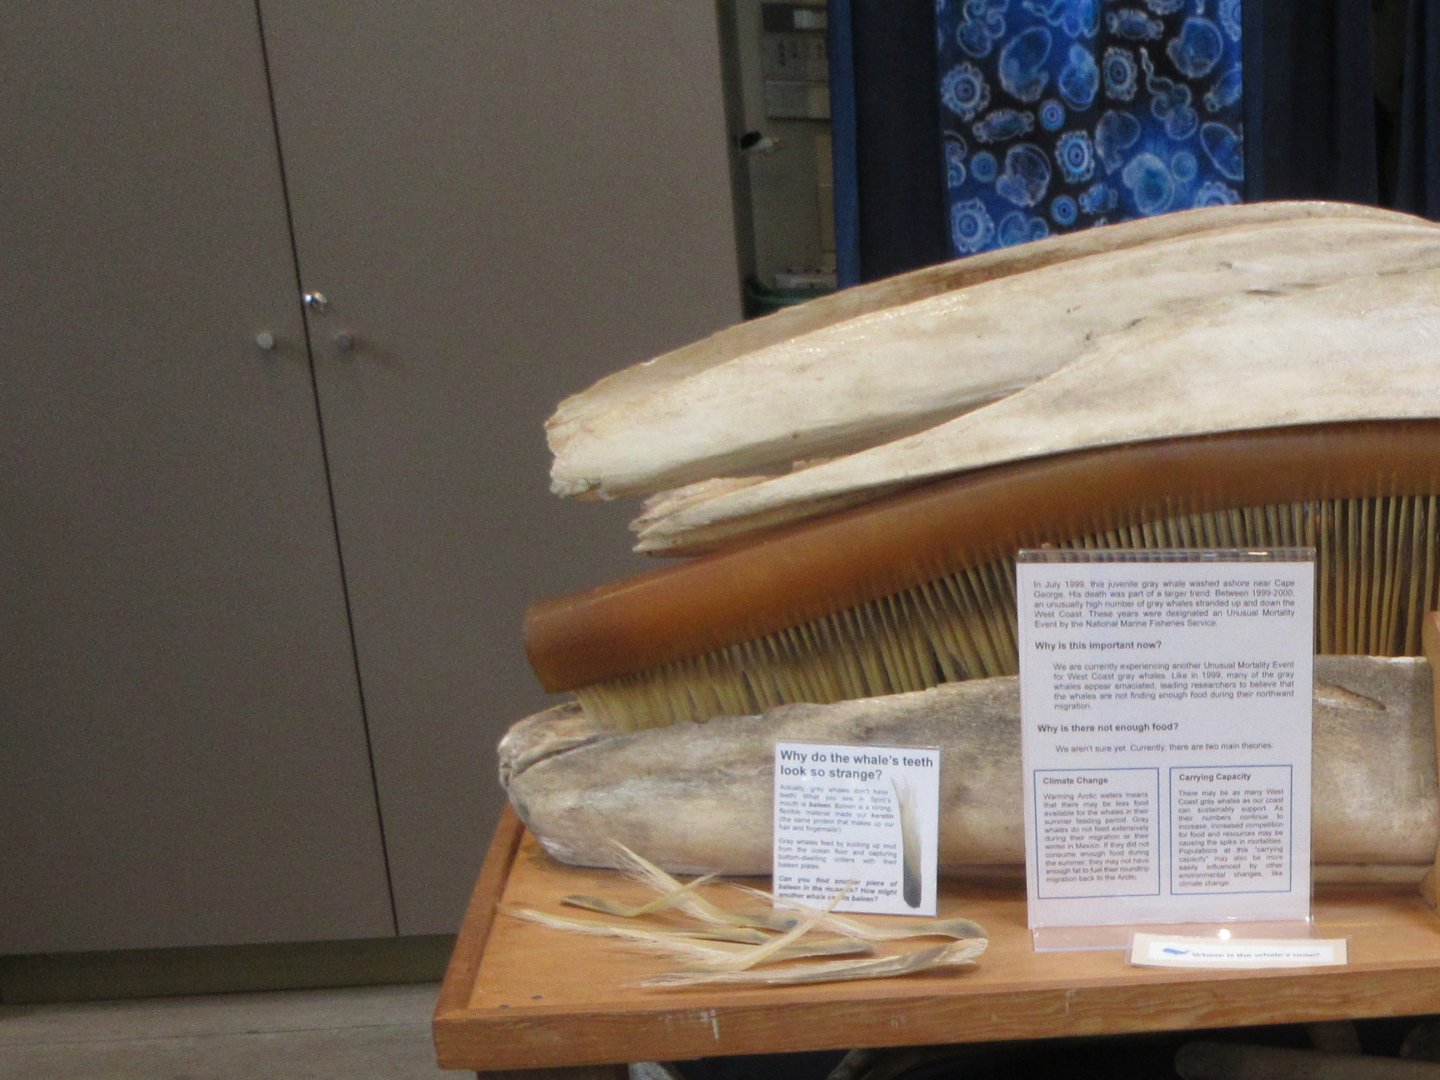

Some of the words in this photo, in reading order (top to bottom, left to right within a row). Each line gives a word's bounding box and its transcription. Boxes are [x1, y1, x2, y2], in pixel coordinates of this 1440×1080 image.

[1035, 642, 1056, 651] Why
[1089, 641, 1134, 651] important
[1137, 640, 1161, 649] now?
[1037, 725, 1058, 734] Why
[1071, 724, 1095, 732] there
[1098, 724, 1112, 732] not
[1115, 723, 1150, 733] enough
[1152, 722, 1178, 731] food?
[781, 751, 807, 764] Why
[811, 752, 827, 762] do
[831, 753, 849, 763] the
[854, 755, 899, 766] whale's
[903, 757, 932, 767] teeth
[781, 766, 806, 776] look
[829, 768, 882, 781] strange?
[1179, 774, 1214, 782] Carrying
[1216, 773, 1251, 781] Capacity
[1077, 777, 1108, 785] Change
